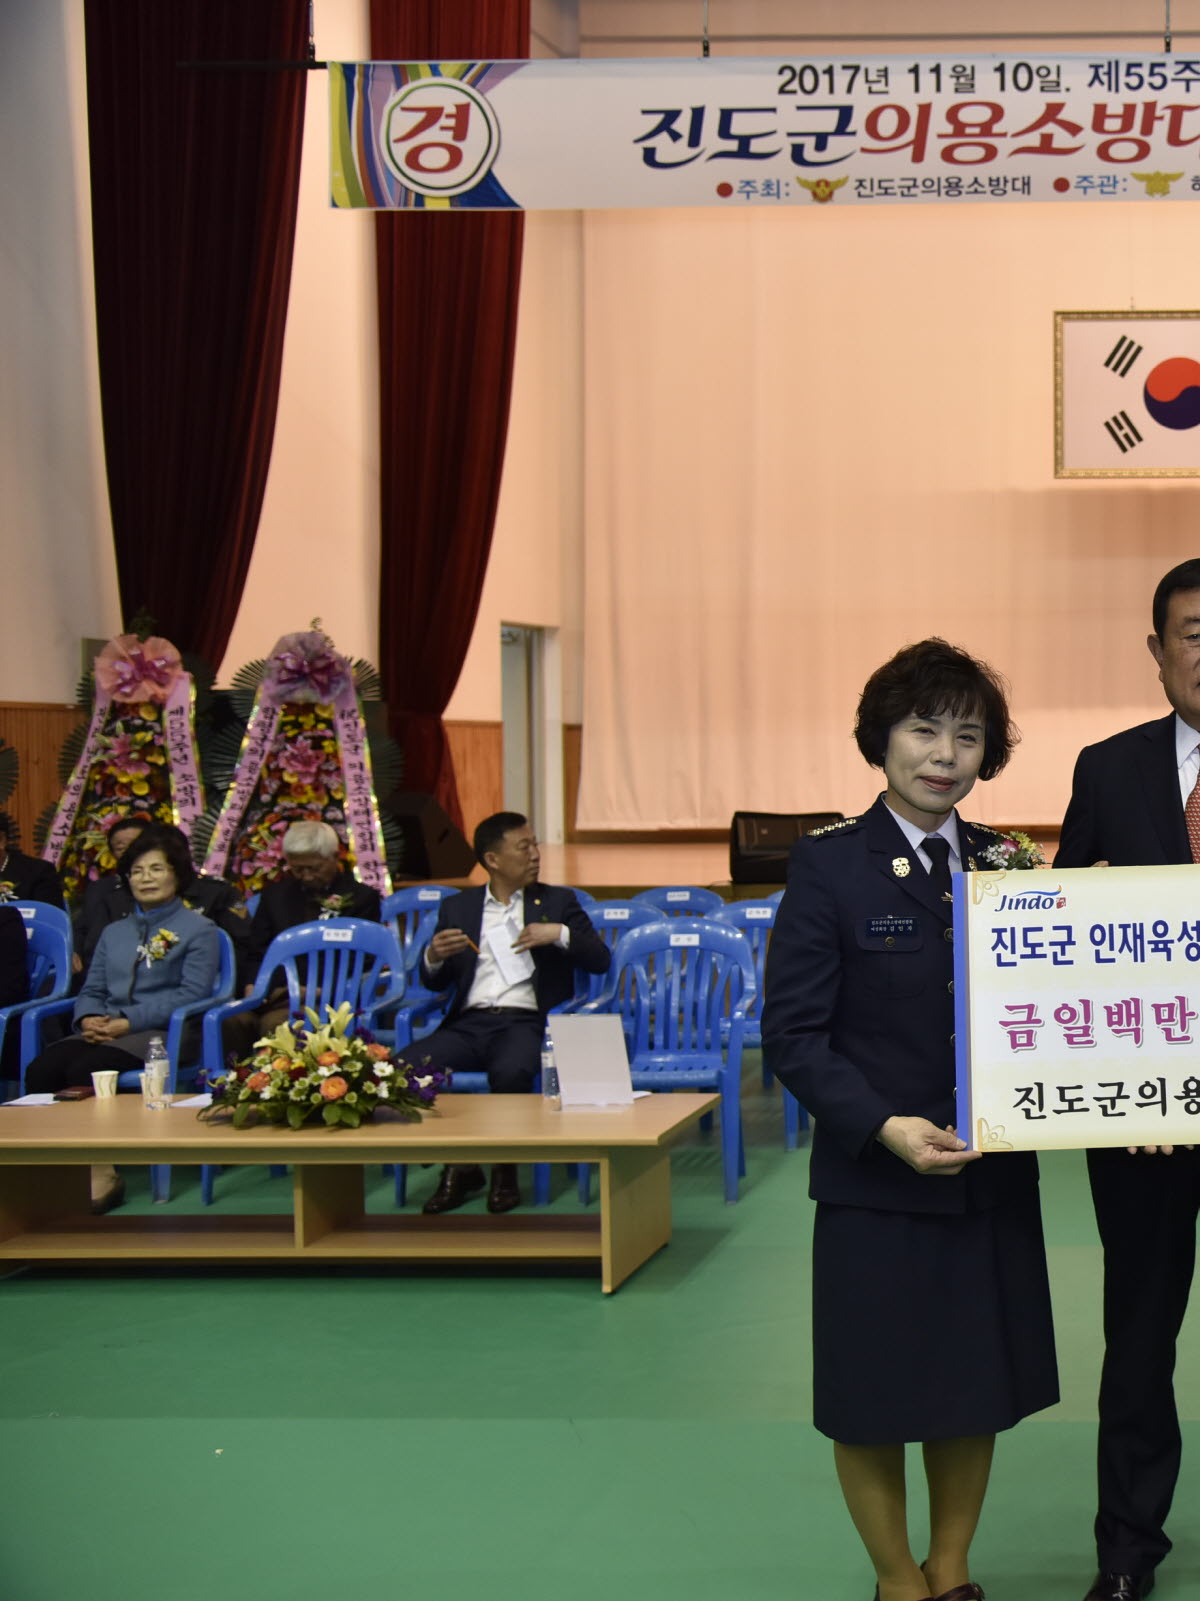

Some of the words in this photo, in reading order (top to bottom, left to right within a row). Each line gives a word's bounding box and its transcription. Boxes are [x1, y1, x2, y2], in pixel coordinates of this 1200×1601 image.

[776, 63, 890, 96] 2017년
[907, 62, 977, 95] 11월
[992, 61, 1072, 94] 10일.
[393, 101, 472, 175] 경
[736, 178, 791, 200] 주최:
[853, 175, 1032, 199] 진도군의용소방대
[1073, 175, 1130, 196] 주관:
[993, 894, 1056, 913] Jindo
[990, 925, 1077, 968] 진도군
